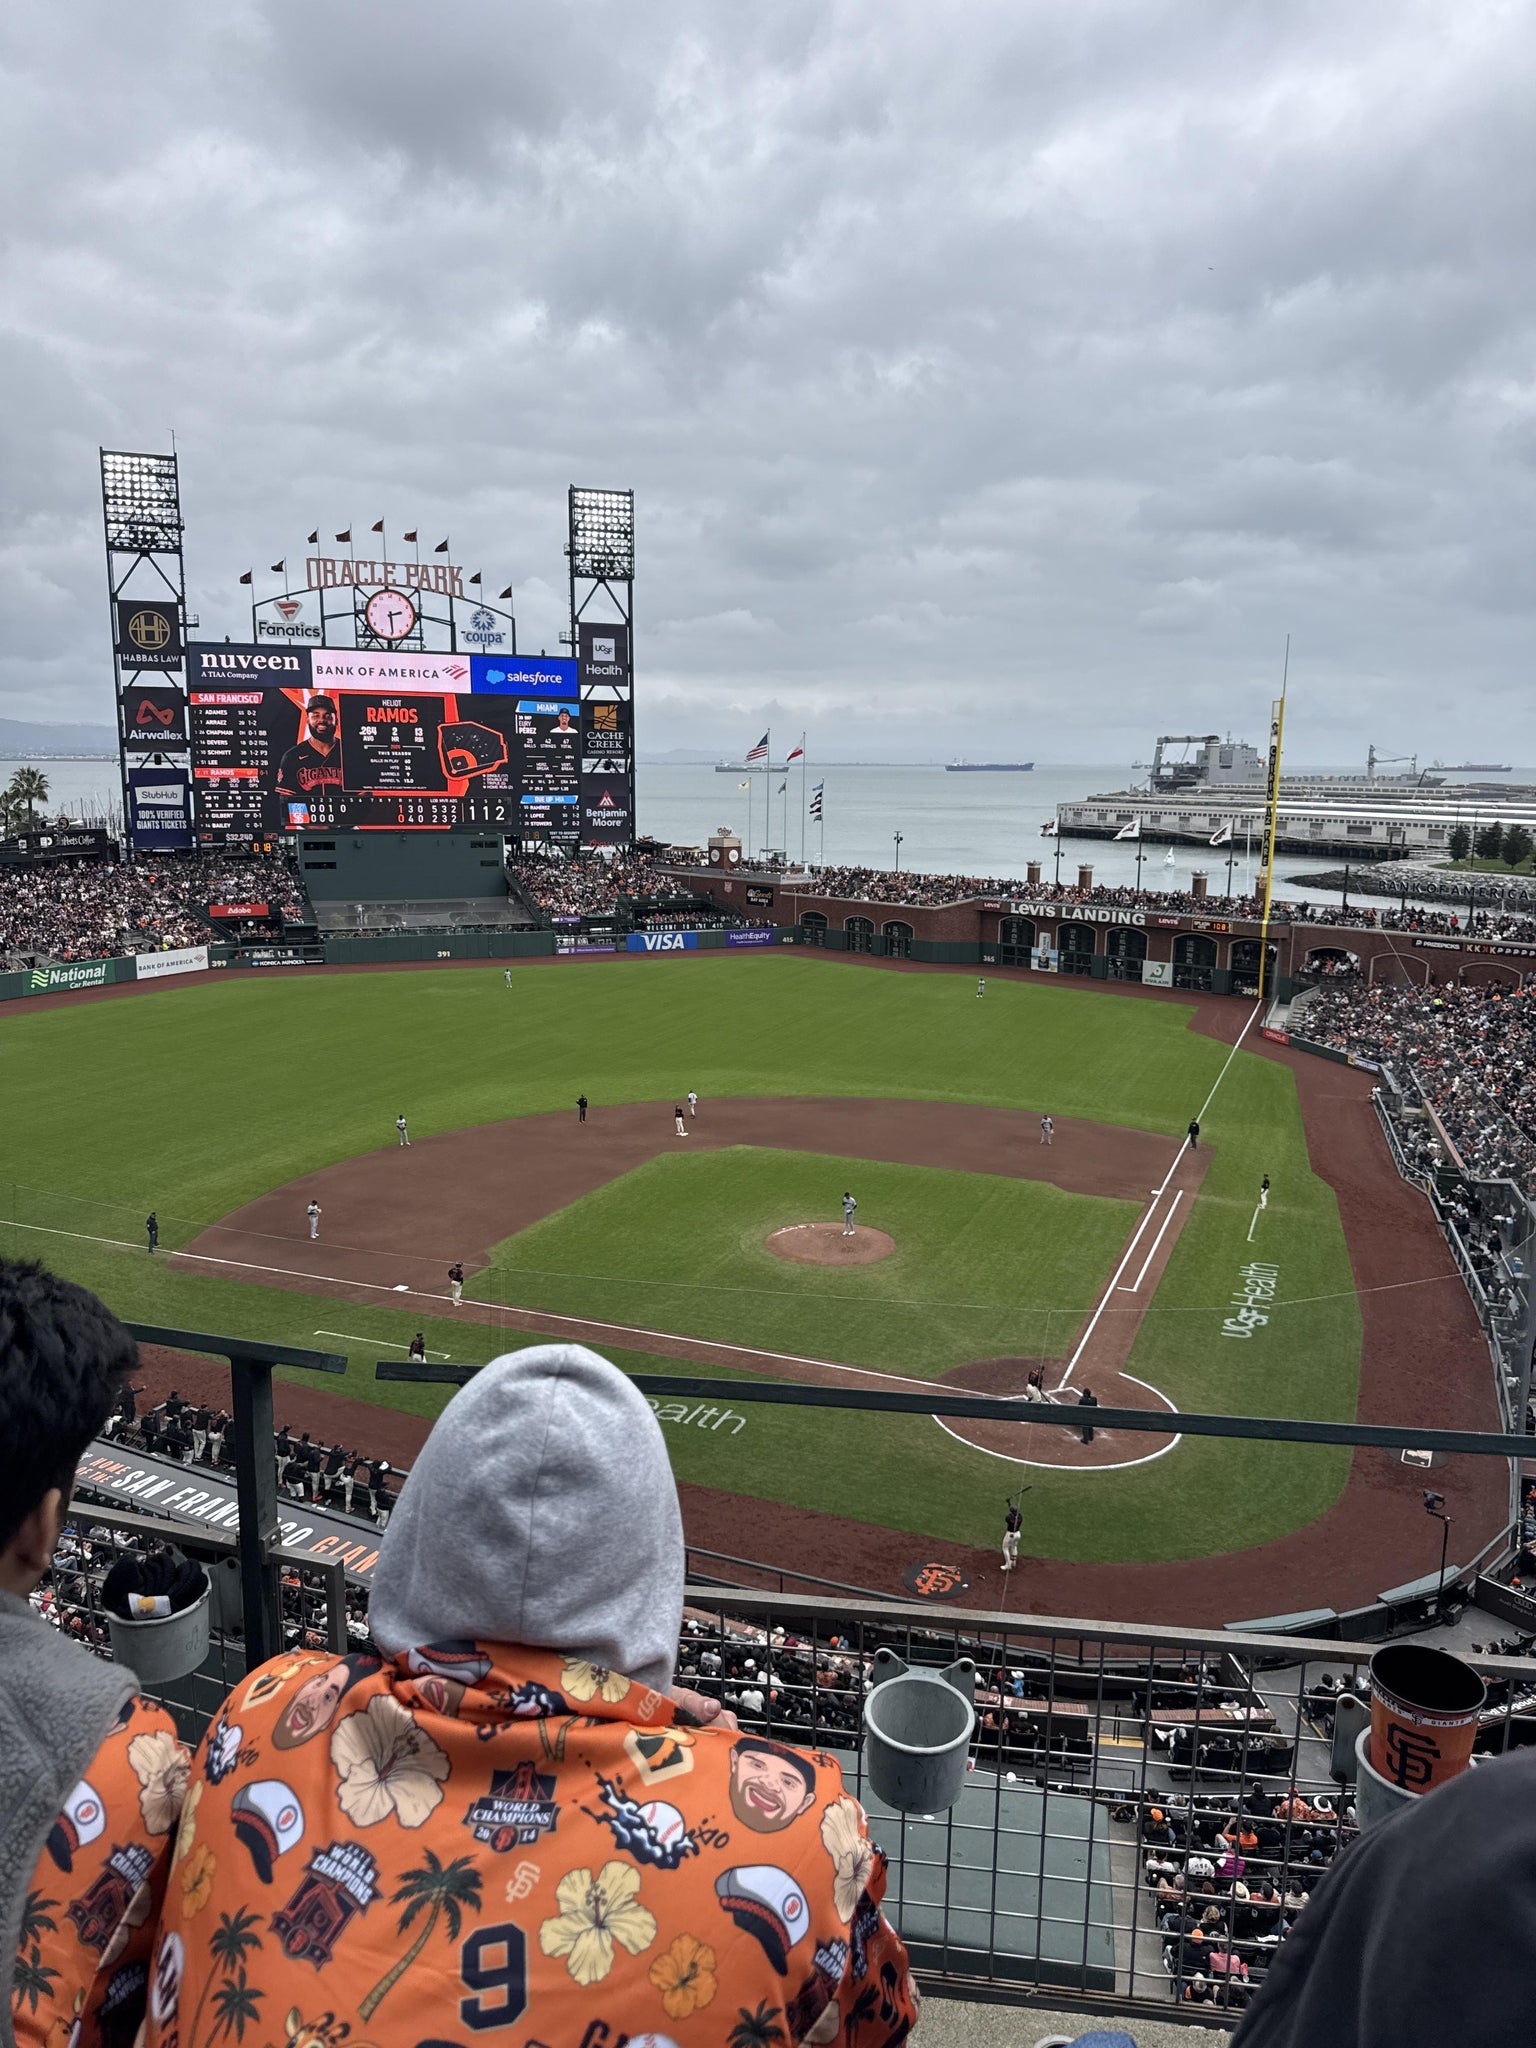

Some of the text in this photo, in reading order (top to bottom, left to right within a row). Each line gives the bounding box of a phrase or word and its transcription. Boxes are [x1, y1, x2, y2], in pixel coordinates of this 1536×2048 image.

[306, 557, 464, 598] ORACLE PARK
[258, 620, 321, 639] Fanatics
[465, 632, 503, 645] coupa
[595, 645, 612, 654] UCSF
[123, 654, 158, 662] HABBAS
[200, 653, 301, 671] nuveen
[227, 672, 258, 680] Company
[316, 666, 439, 679] BANK OF AMERICA
[586, 664, 622, 675] Health
[507, 671, 562, 685] salesforce
[199, 694, 258, 703] SAN FRANCISCO
[367, 707, 418, 723] RAMOS
[130, 730, 183, 740] Airwallex
[359, 726, 423, 736] .264 2 13
[588, 740, 623, 748] CREEK
[142, 790, 178, 799] StubHub
[138, 810, 184, 819] 100% VERIFIED
[310, 804, 316, 813] 0
[319, 804, 325, 813] 0
[340, 804, 346, 813] 0
[399, 804, 402, 813] 1
[408, 805, 414, 813] 3
[418, 805, 423, 813] 0
[432, 805, 437, 813] 5
[442, 805, 447, 813] 3
[451, 805, 456, 813] 2
[469, 806, 475, 820] 1
[483, 806, 488, 820] 1
[495, 806, 505, 820] 2
[311, 814, 317, 822] 0
[320, 814, 326, 822] 0
[328, 814, 334, 822] 0
[398, 814, 404, 823] 0
[418, 815, 424, 823] 0
[451, 815, 457, 823] 2
[586, 808, 627, 818] Benjamin
[137, 821, 187, 829] GIANTS TICKETS
[592, 818, 622, 826] Moore
[78, 835, 96, 846] Coffee
[1378, 881, 1529, 900] BANK OF AMERICA
[1062, 907, 1146, 926] LANDING
[641, 934, 685, 950] VISA
[138, 963, 155, 972] BANK
[166, 958, 194, 968] AMERICA
[50, 964, 106, 984] National
[82, 978, 104, 987] Rental
[1242, 987, 1258, 996] 309
[1265, 1031, 1286, 1041] ORACLE
[1230, 1262, 1280, 1309] Health
[90, 1457, 132, 1475] HOME
[75, 1466, 113, 1483] OF THE
[110, 1470, 175, 1499] SAN
[492, 1799, 540, 1812] WORLD
[472, 1809, 551, 1825] CHAMPIONS
[476, 1827, 536, 1841] 20 14
[330, 1846, 375, 1884] WORLD
[311, 1854, 373, 1905] CHAMPIONS
[460, 1922, 528, 2032] 9
